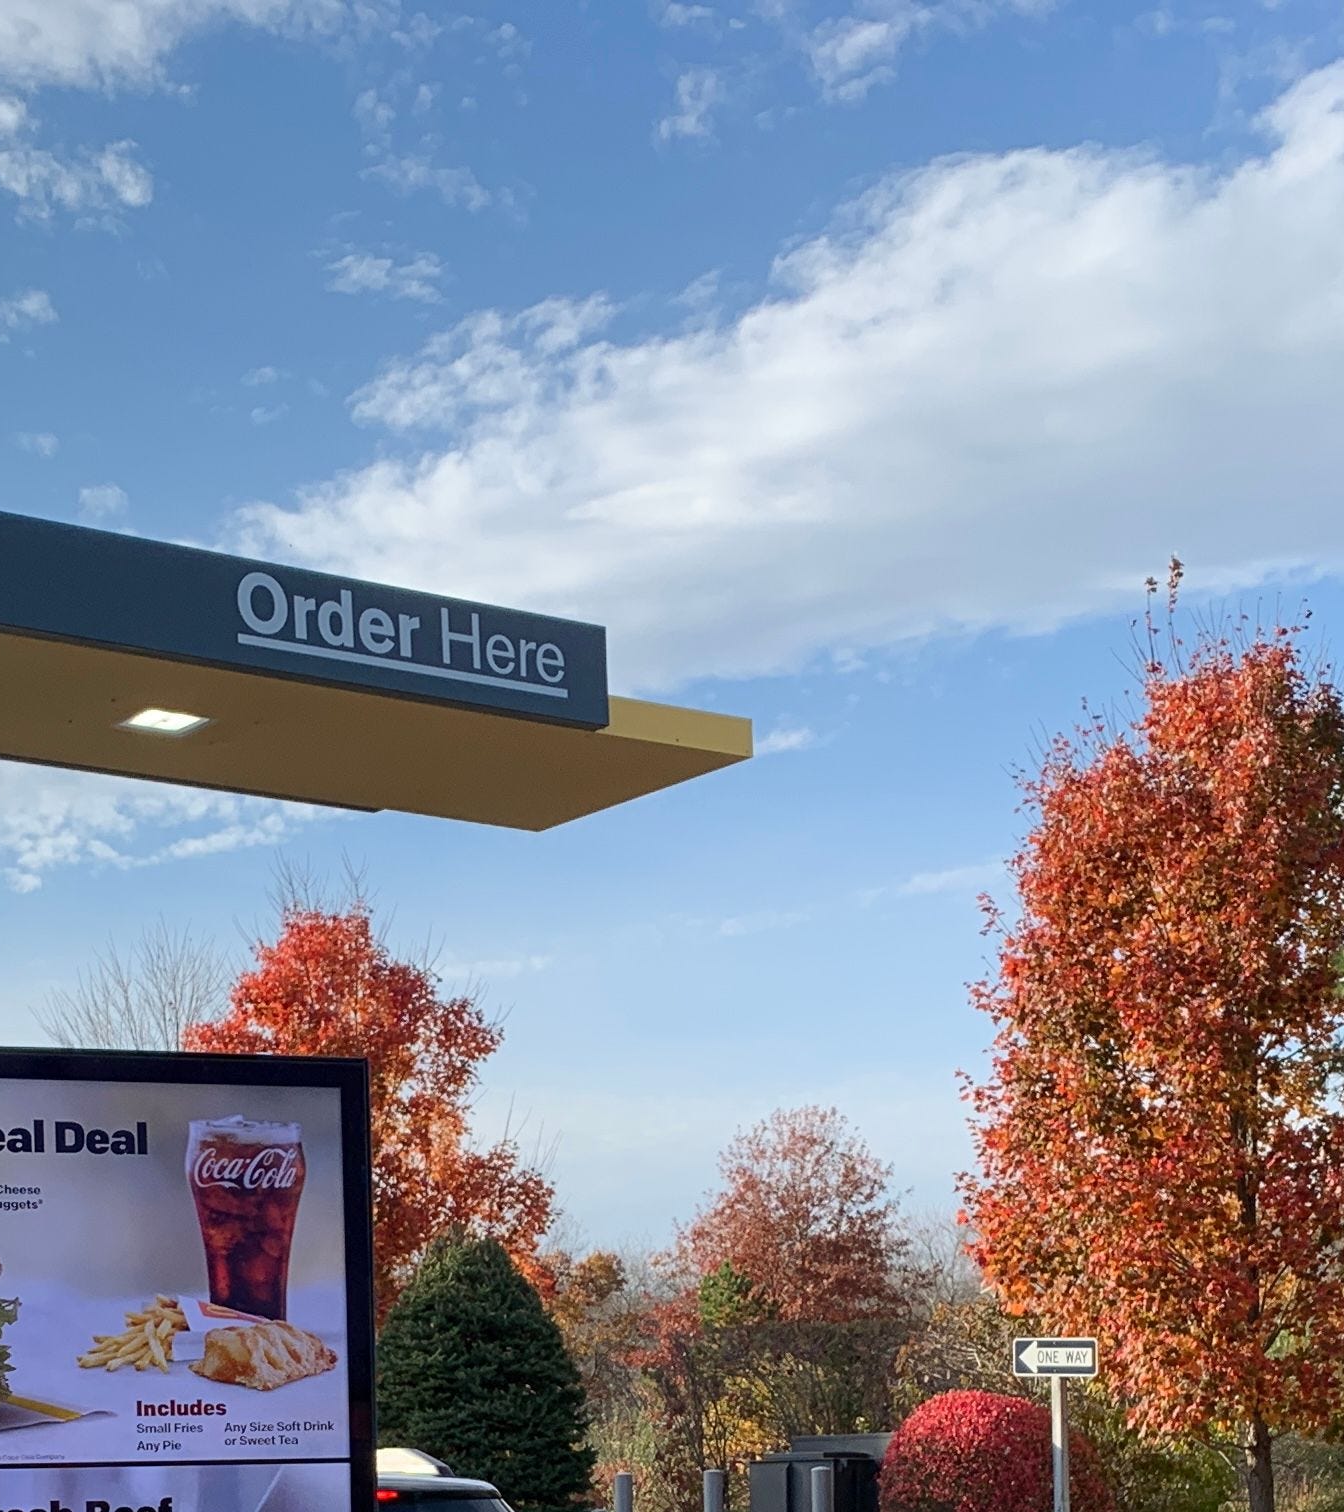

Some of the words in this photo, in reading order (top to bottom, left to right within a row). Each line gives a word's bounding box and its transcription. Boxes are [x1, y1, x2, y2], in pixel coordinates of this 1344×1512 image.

[237, 571, 420, 658] Order
[440, 607, 566, 684] Here
[55, 1121, 149, 1155] Deal
[194, 1148, 298, 1189] Coca-Cola
[1037, 1350, 1059, 1364] ONE
[1066, 1350, 1088, 1364] WAY
[137, 1400, 227, 1417] Includes
[137, 1423, 171, 1434] Small
[174, 1423, 203, 1433] Fries
[224, 1423, 247, 1435] Any
[249, 1422, 274, 1432] Size
[277, 1422, 301, 1432] Soft
[303, 1421, 335, 1431] Drink
[137, 1441, 160, 1453] Any
[163, 1440, 182, 1450] Pie
[225, 1437, 236, 1446] or
[239, 1436, 276, 1446] Sweet
[278, 1435, 299, 1445] Tea
